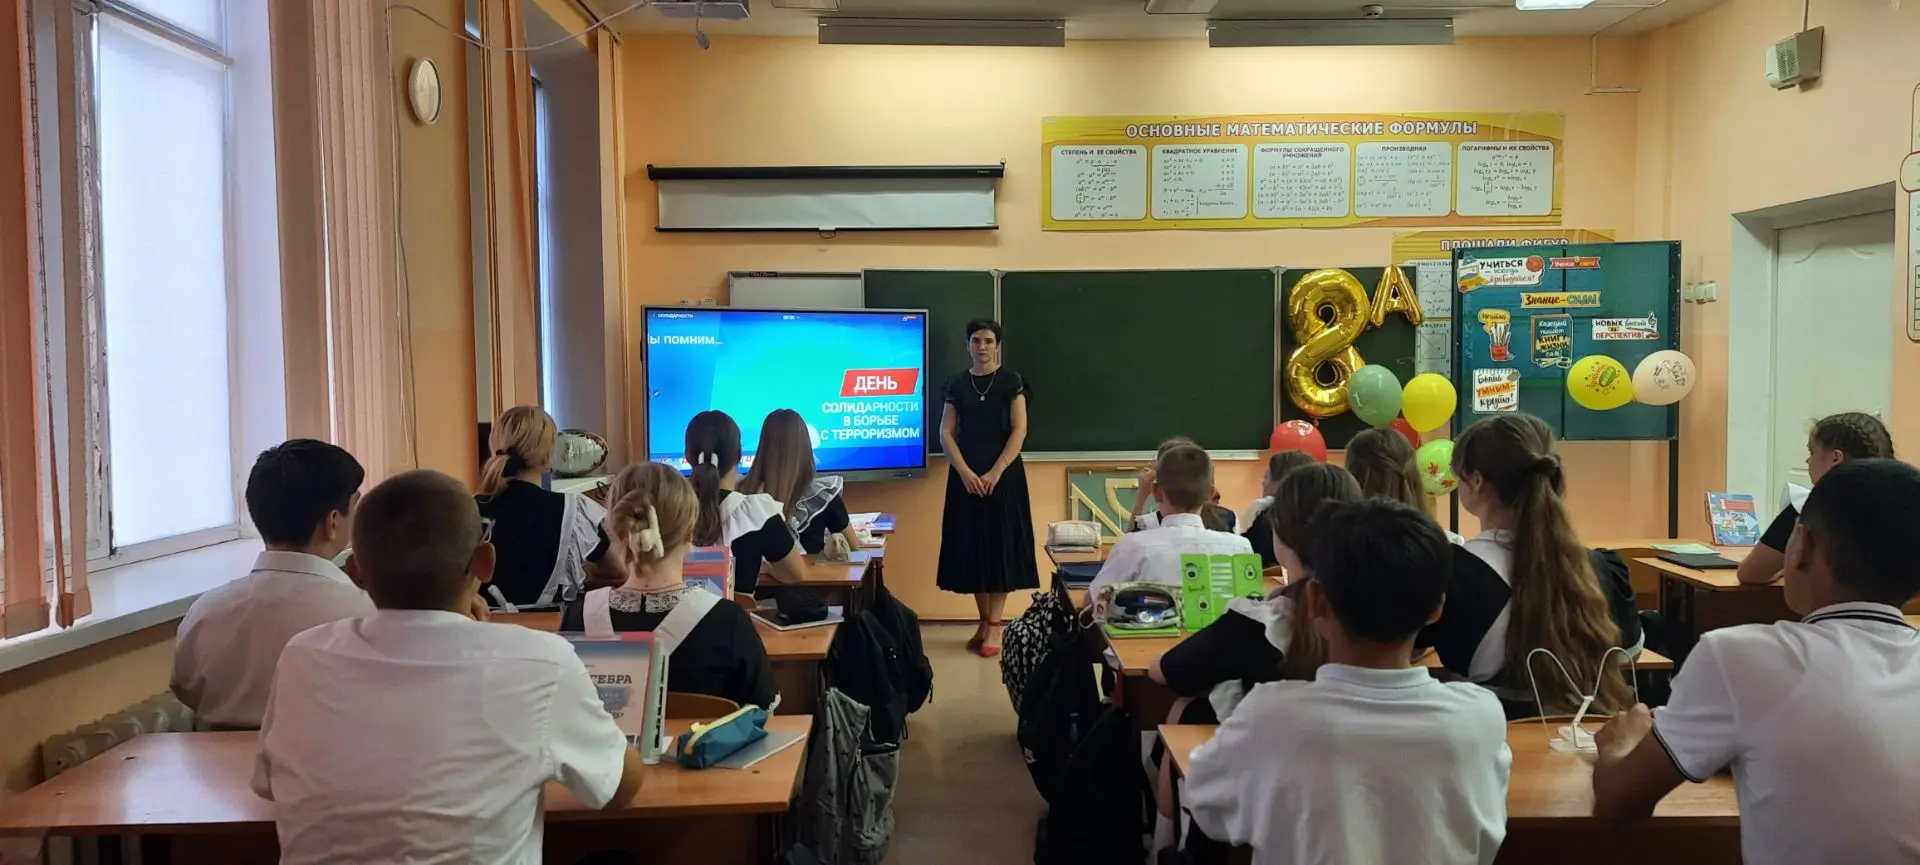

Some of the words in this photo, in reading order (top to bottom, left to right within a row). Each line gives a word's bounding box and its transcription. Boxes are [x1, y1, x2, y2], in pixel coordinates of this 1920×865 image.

[1126, 123, 1221, 138] ОСНОВНЫЕ
[1226, 121, 1384, 137] МАТЕМАТИЧЕСКИЕ
[1389, 120, 1478, 135] ФОРМУЛЫ
[1480, 259, 1523, 270] УЧИТЬСЯ
[854, 375, 899, 393] ДЕНЬ
[822, 401, 919, 414] СОЛИДАРНОСТИ
[843, 416, 851, 426] В
[854, 414, 899, 426] БОРЬБЕ
[820, 429, 829, 440] С
[832, 428, 920, 440] ТЕРРОРИЗМОМ
[590, 674, 632, 684] ГЕБРА
